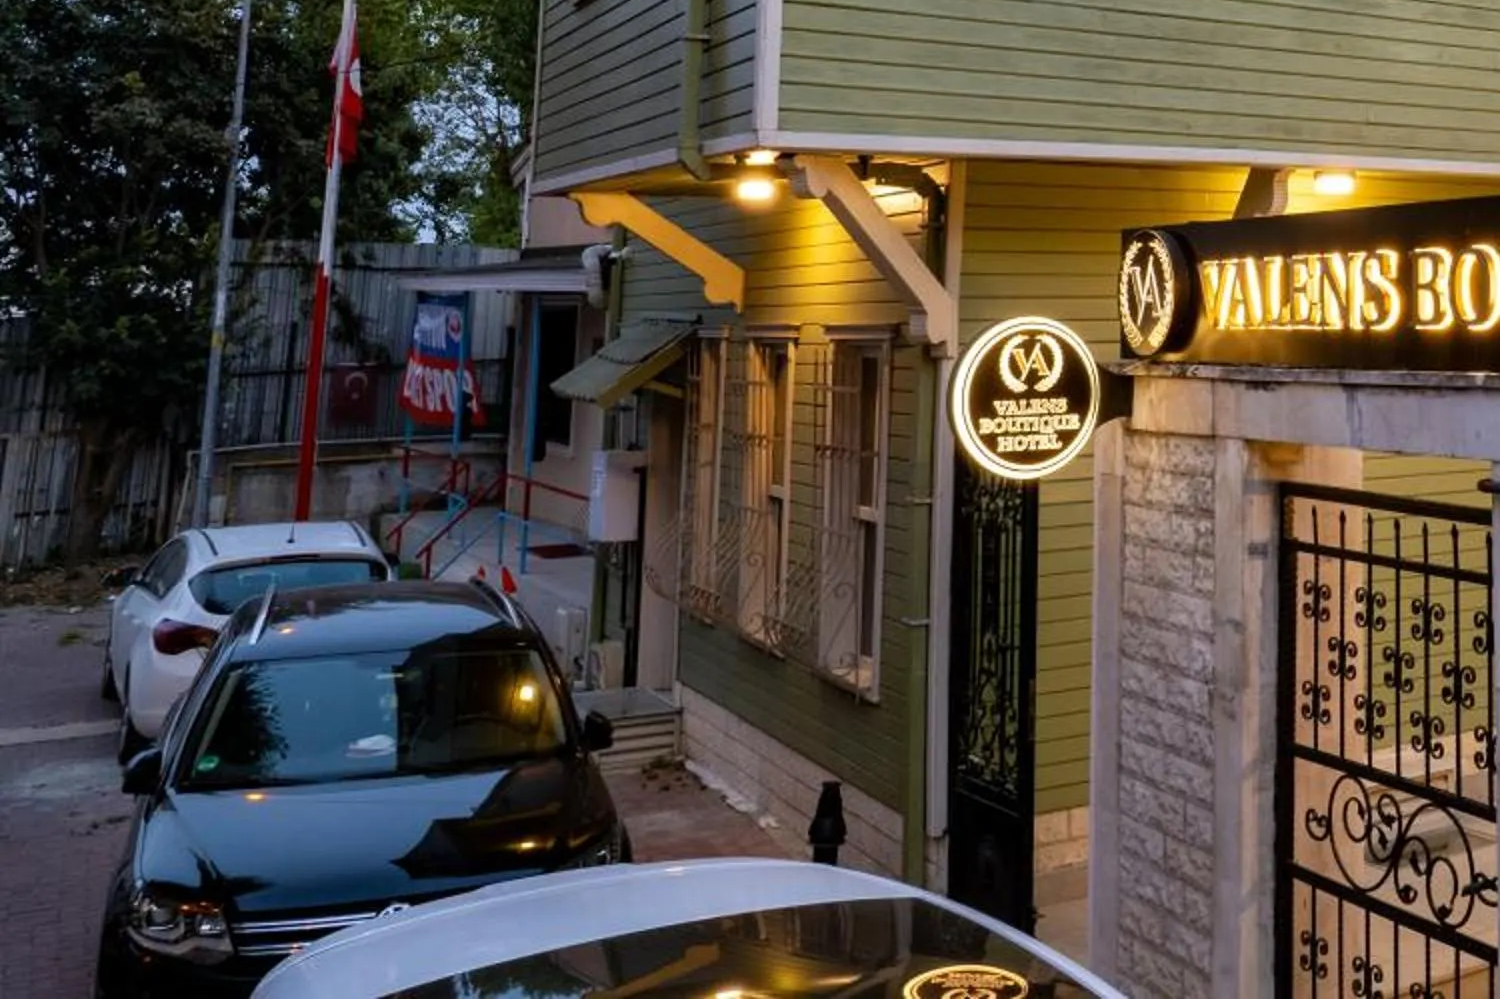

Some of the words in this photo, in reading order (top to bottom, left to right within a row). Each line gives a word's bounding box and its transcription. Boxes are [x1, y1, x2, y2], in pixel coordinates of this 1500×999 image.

[1200, 249, 1399, 332] VALENS
[993, 397, 1067, 415] VALENS
[997, 433, 1063, 452] HOTEL
